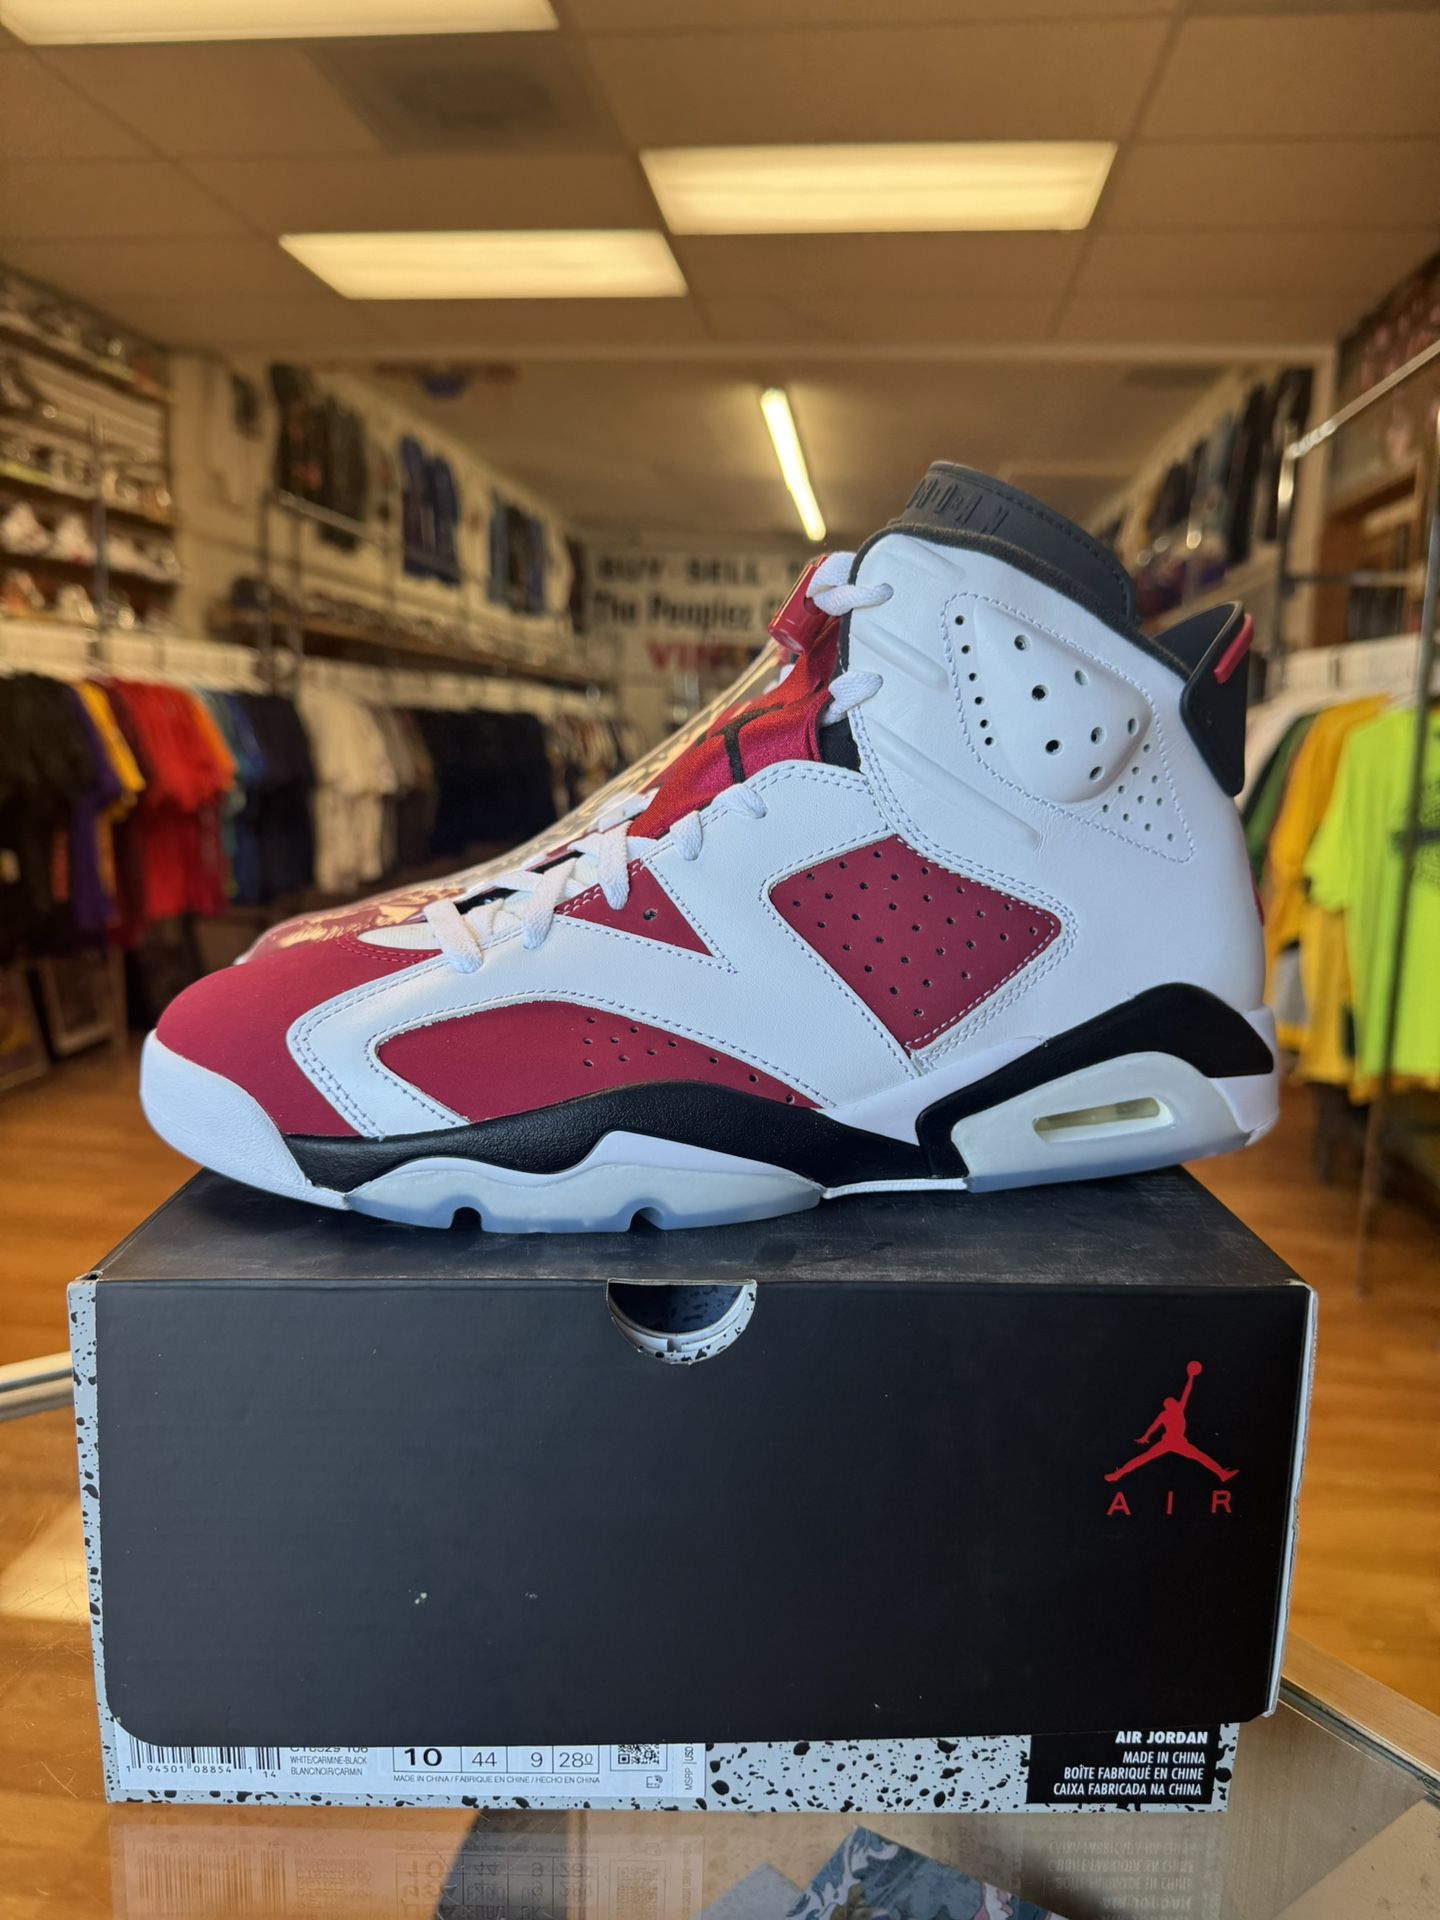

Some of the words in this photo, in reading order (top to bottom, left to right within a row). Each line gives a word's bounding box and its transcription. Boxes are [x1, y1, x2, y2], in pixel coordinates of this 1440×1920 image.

[1105, 1490, 1232, 1516] AIR
[1115, 1731, 1141, 1744] AIR
[1147, 1731, 1208, 1744] JORDAN
[290, 1755, 367, 1765] WHITE/CARMINE-BLACK
[404, 1748, 442, 1766] 10
[471, 1752, 497, 1767] 44
[530, 1752, 543, 1768] 9
[1123, 1751, 1153, 1764] MADE
[1157, 1751, 1169, 1764] IN
[1172, 1751, 1206, 1764] CHINA
[147, 1765, 184, 1773] 94501
[194, 1765, 232, 1774] 08854
[263, 1771, 277, 1779] 14
[1064, 1764, 1095, 1780] BOÎTE
[1154, 1768, 1168, 1780] EN
[1171, 1768, 1204, 1780] CHINE
[455, 1775, 492, 1783] FABRIQUE
[577, 1776, 600, 1784] CHINA
[1053, 1783, 1085, 1795] CAIXA
[1088, 1783, 1147, 1795] FABRICADA
[1150, 1783, 1165, 1795] NA
[1168, 1783, 1201, 1795] CHINA
